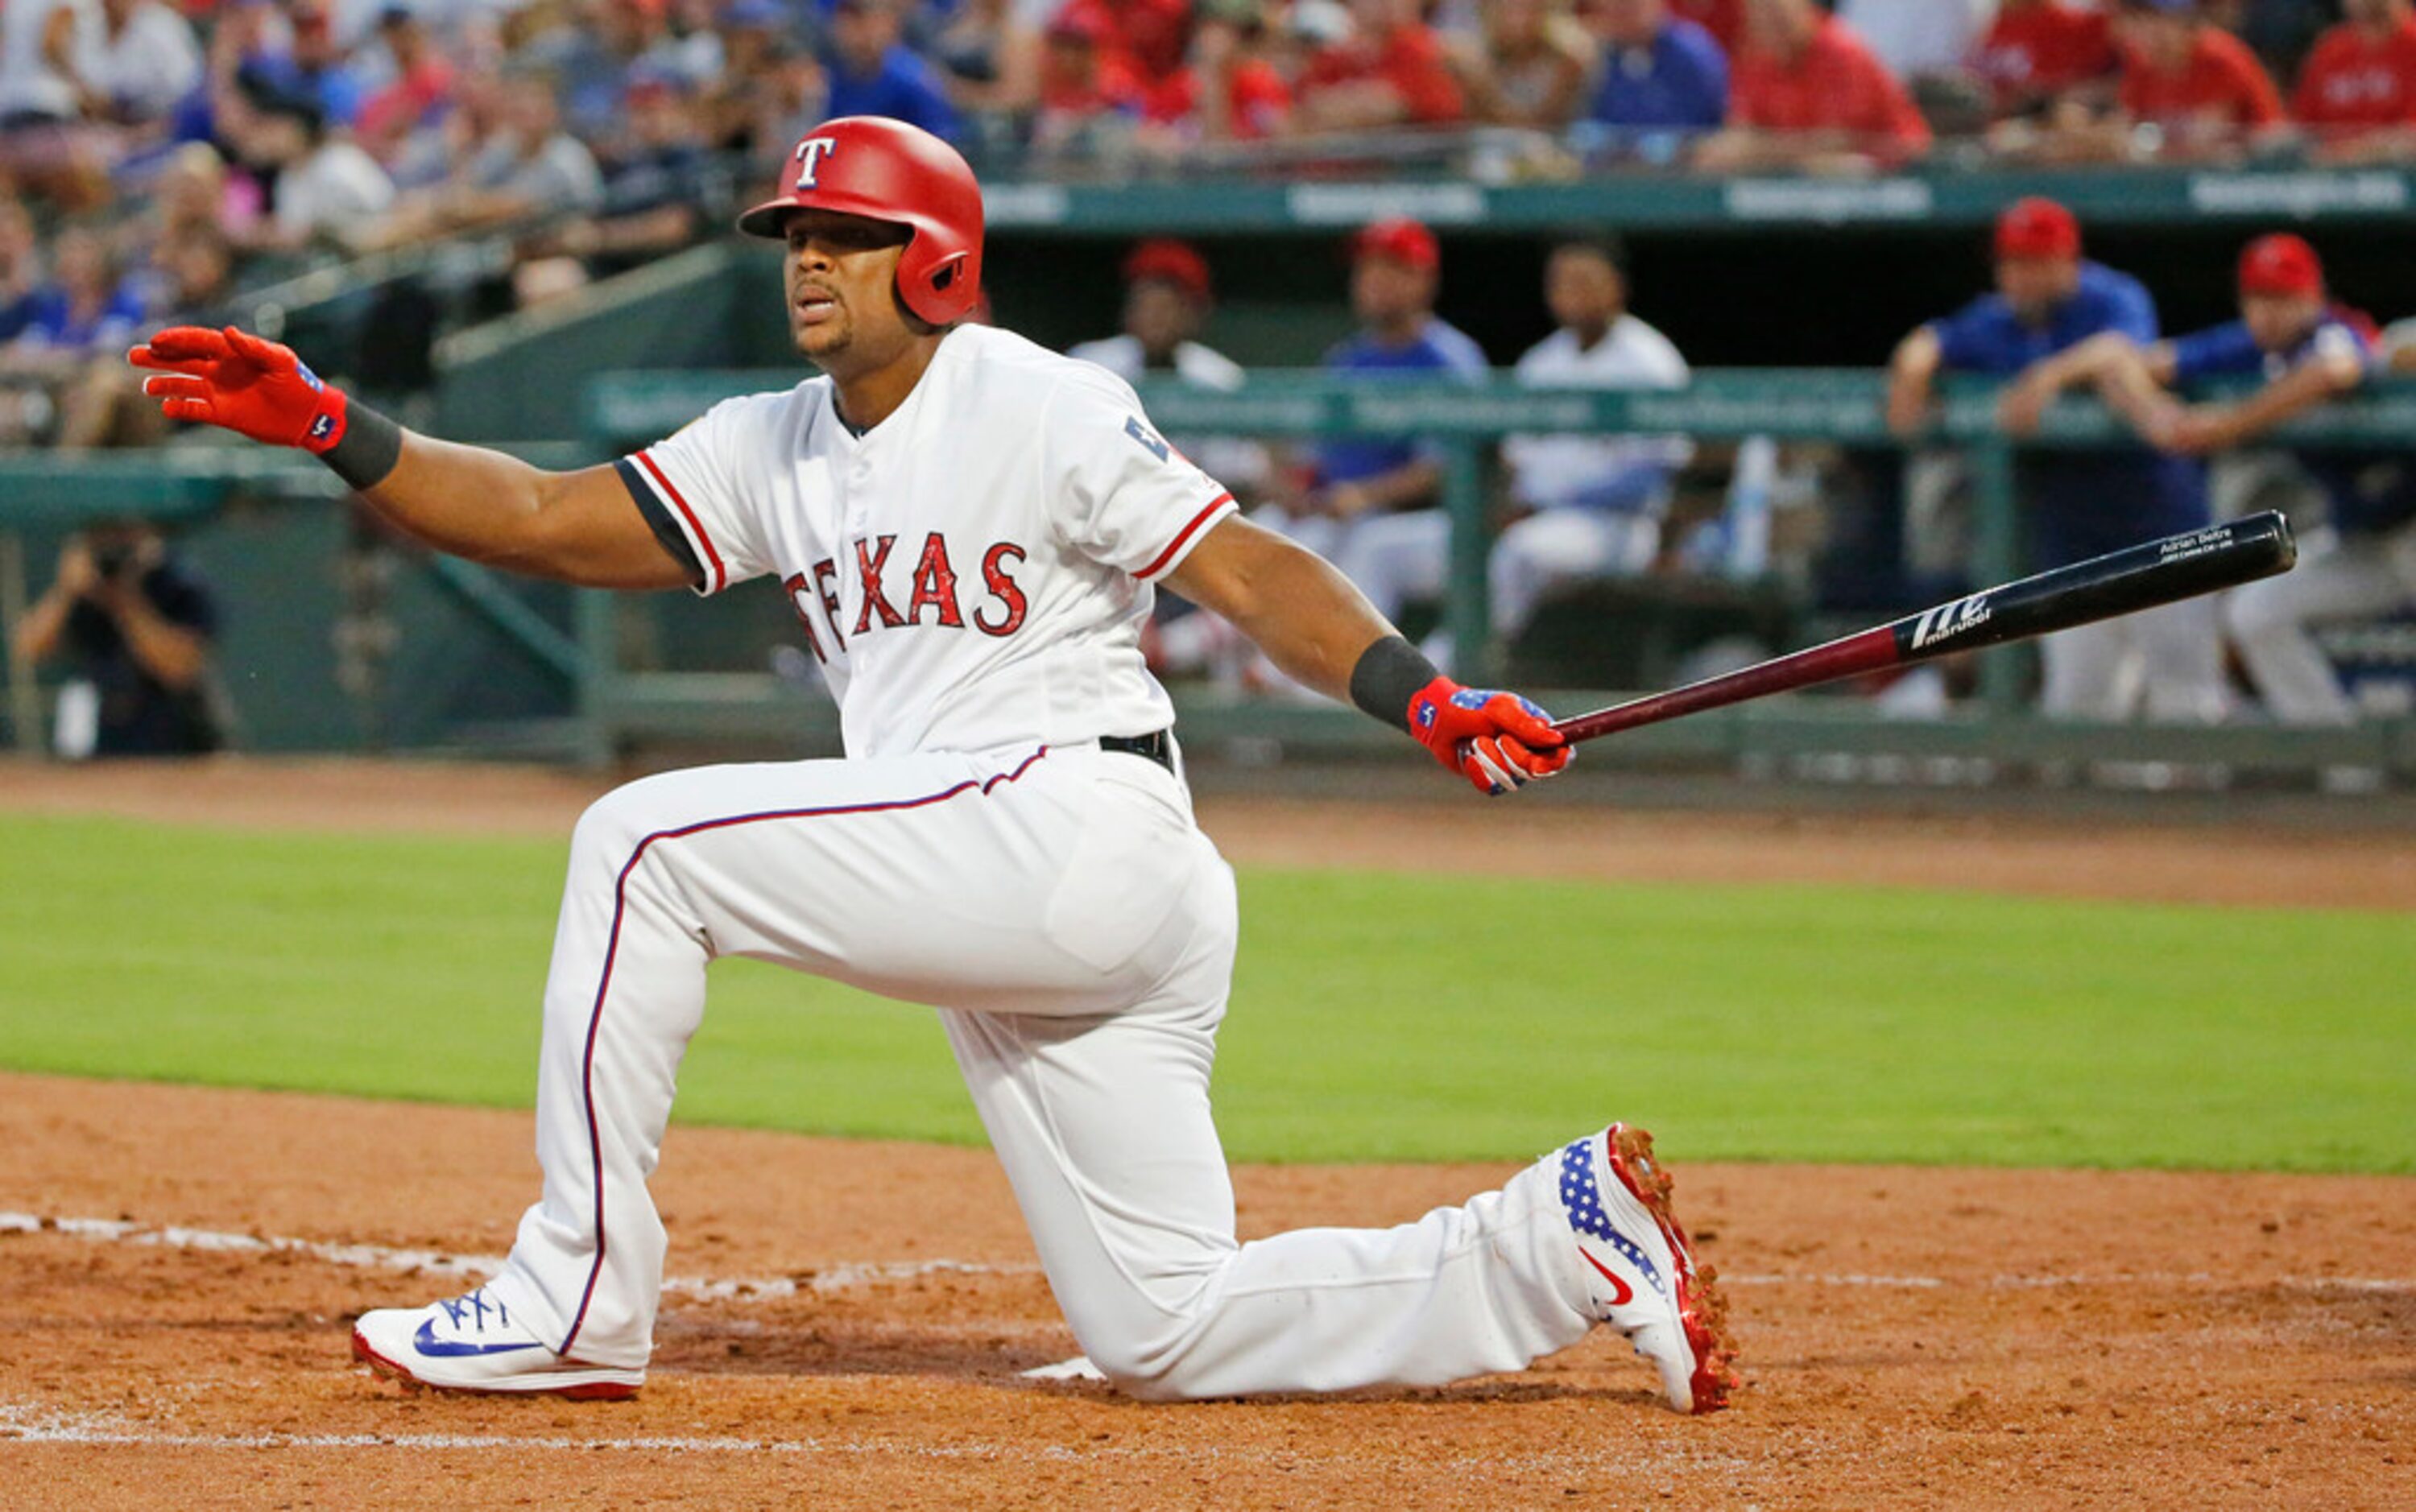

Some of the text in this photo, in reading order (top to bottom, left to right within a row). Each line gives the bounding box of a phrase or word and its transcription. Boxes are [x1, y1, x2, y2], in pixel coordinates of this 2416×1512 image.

[796, 138, 837, 189] T
[2160, 537, 2197, 556] Adrian
[784, 531, 1028, 663] TEXAS
[1924, 608, 1991, 646] marucci
